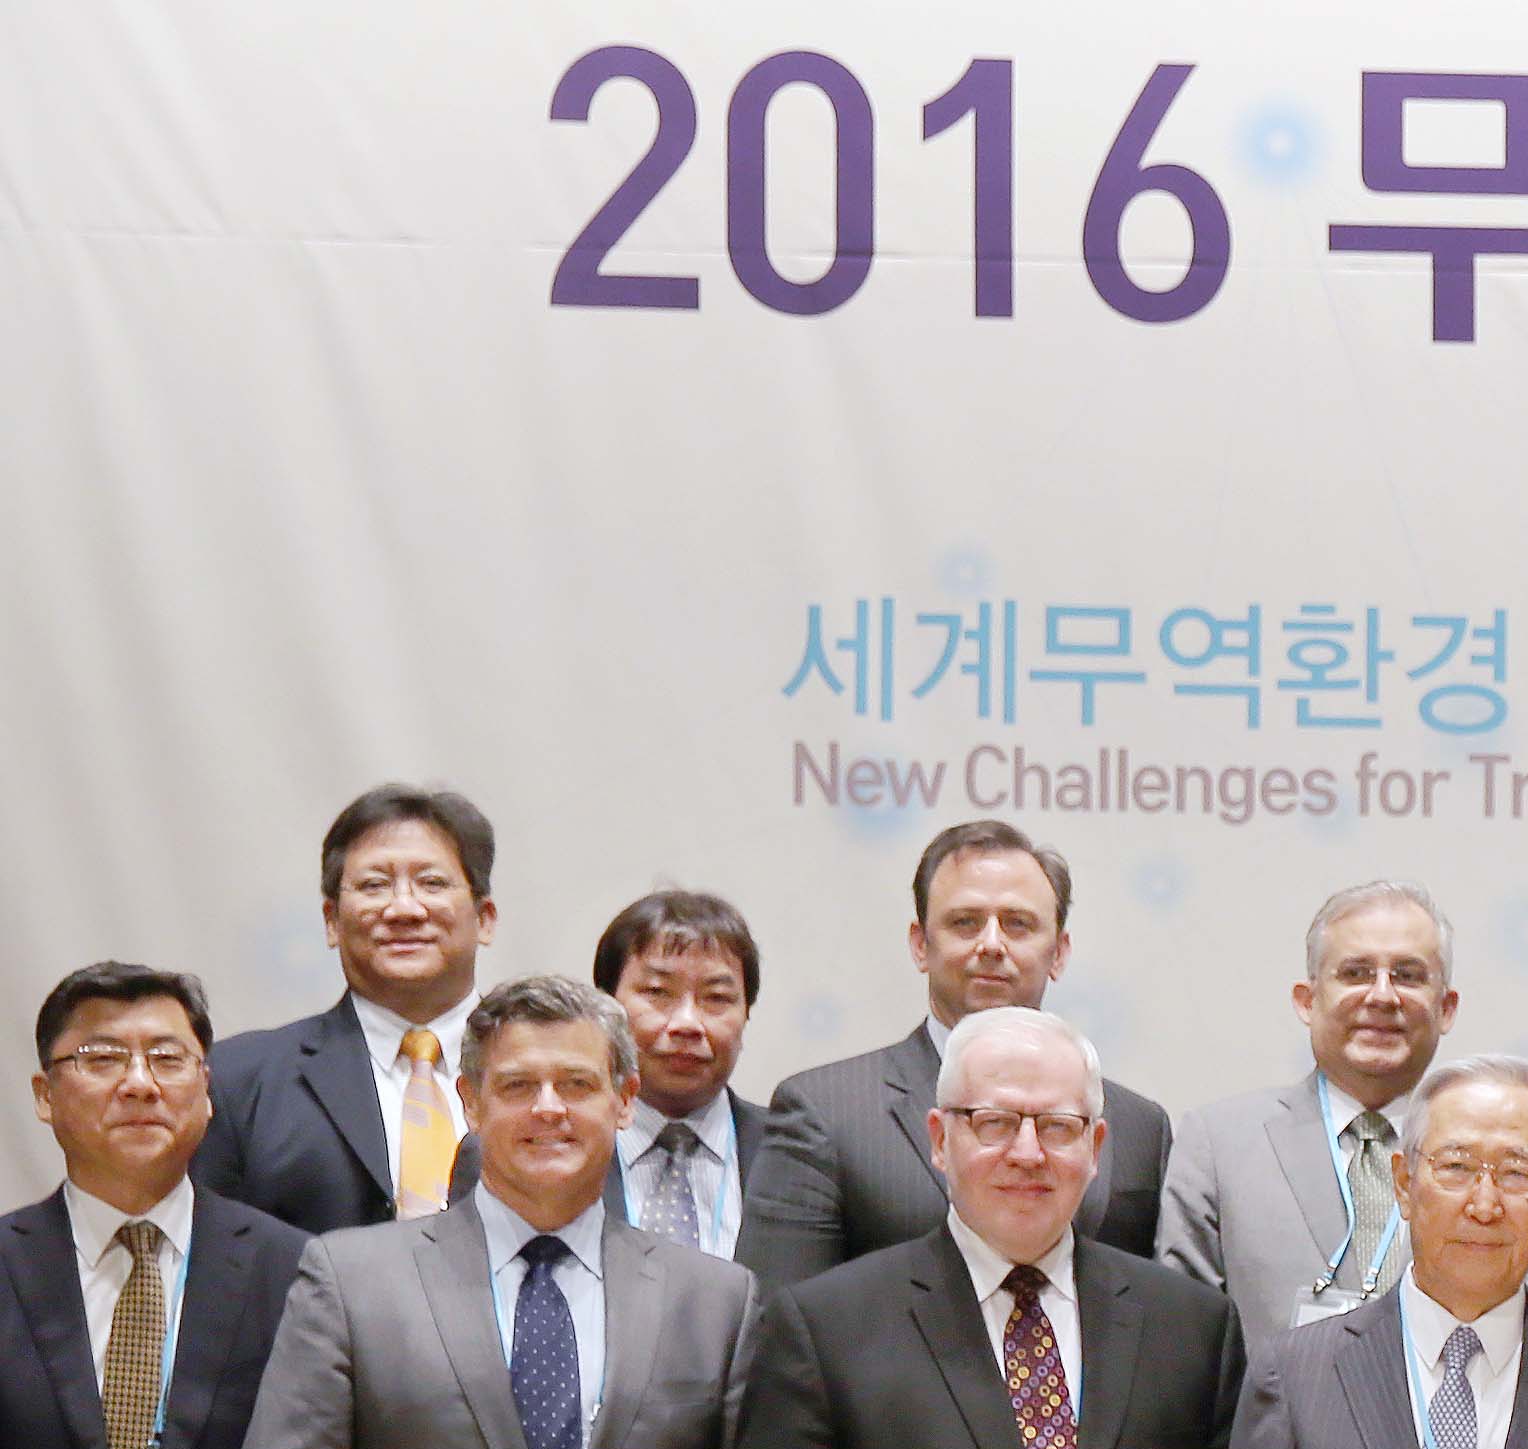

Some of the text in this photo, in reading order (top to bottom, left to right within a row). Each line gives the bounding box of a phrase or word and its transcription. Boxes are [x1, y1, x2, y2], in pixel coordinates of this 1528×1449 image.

[552, 47, 1229, 322] 2016
[782, 599, 1507, 736] 세계무역환경
[791, 741, 946, 809] New
[964, 744, 1338, 825] Challenges
[1355, 752, 1450, 818] for
